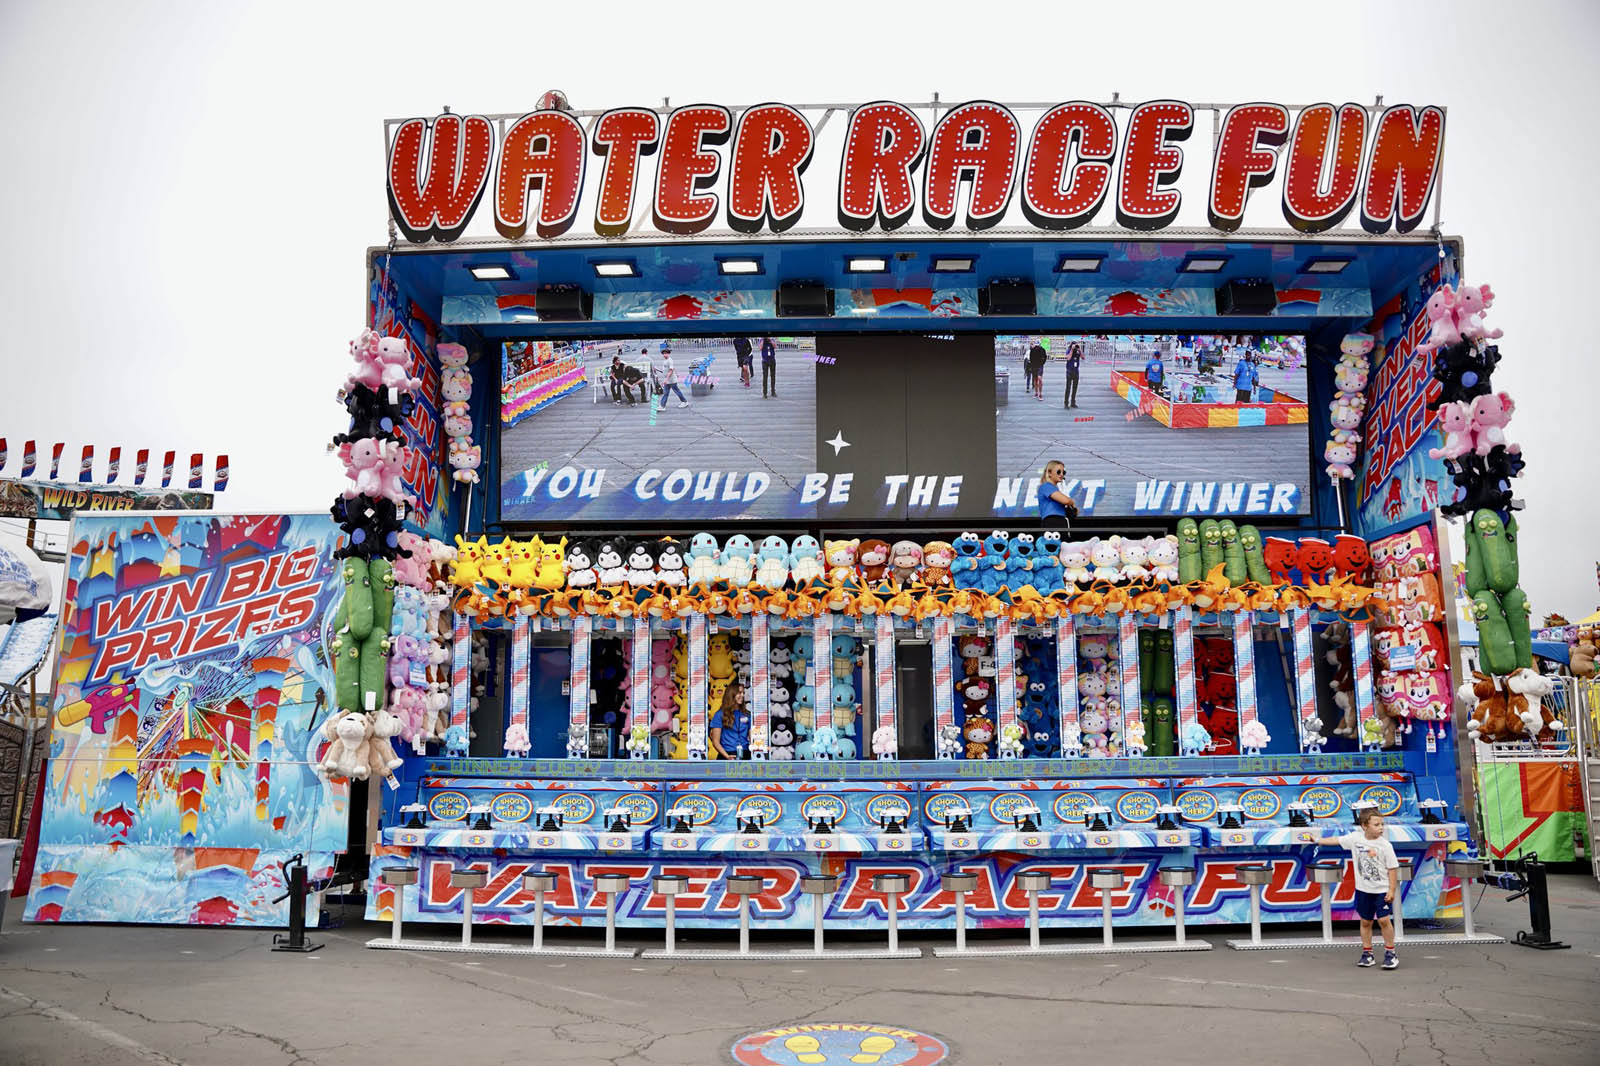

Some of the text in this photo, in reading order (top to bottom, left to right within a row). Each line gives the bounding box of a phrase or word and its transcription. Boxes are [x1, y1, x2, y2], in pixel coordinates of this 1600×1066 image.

[387, 100, 1447, 243] WATER RACE FUN
[43, 488, 134, 511] WILD RIVER
[522, 466, 606, 499] YOU
[635, 469, 770, 503] COULD
[800, 472, 853, 504] BE
[885, 475, 963, 506] THE
[1134, 479, 1297, 514] WINNER
[96, 572, 211, 639] WIN
[219, 547, 317, 604] BIG
[93, 581, 323, 681] PRIZES
[450, 760, 665, 777] WINNER EVERY RACE
[726, 762, 899, 778] WATER GUN FUN
[960, 760, 1178, 776] WINNER EVERY RACE
[1239, 753, 1403, 772] WATER GUN FUN
[407, 834, 411, 842] 1
[427, 861, 801, 912] WATER
[837, 862, 1149, 912] RACE
[762, 1023, 919, 1039] WINNER
